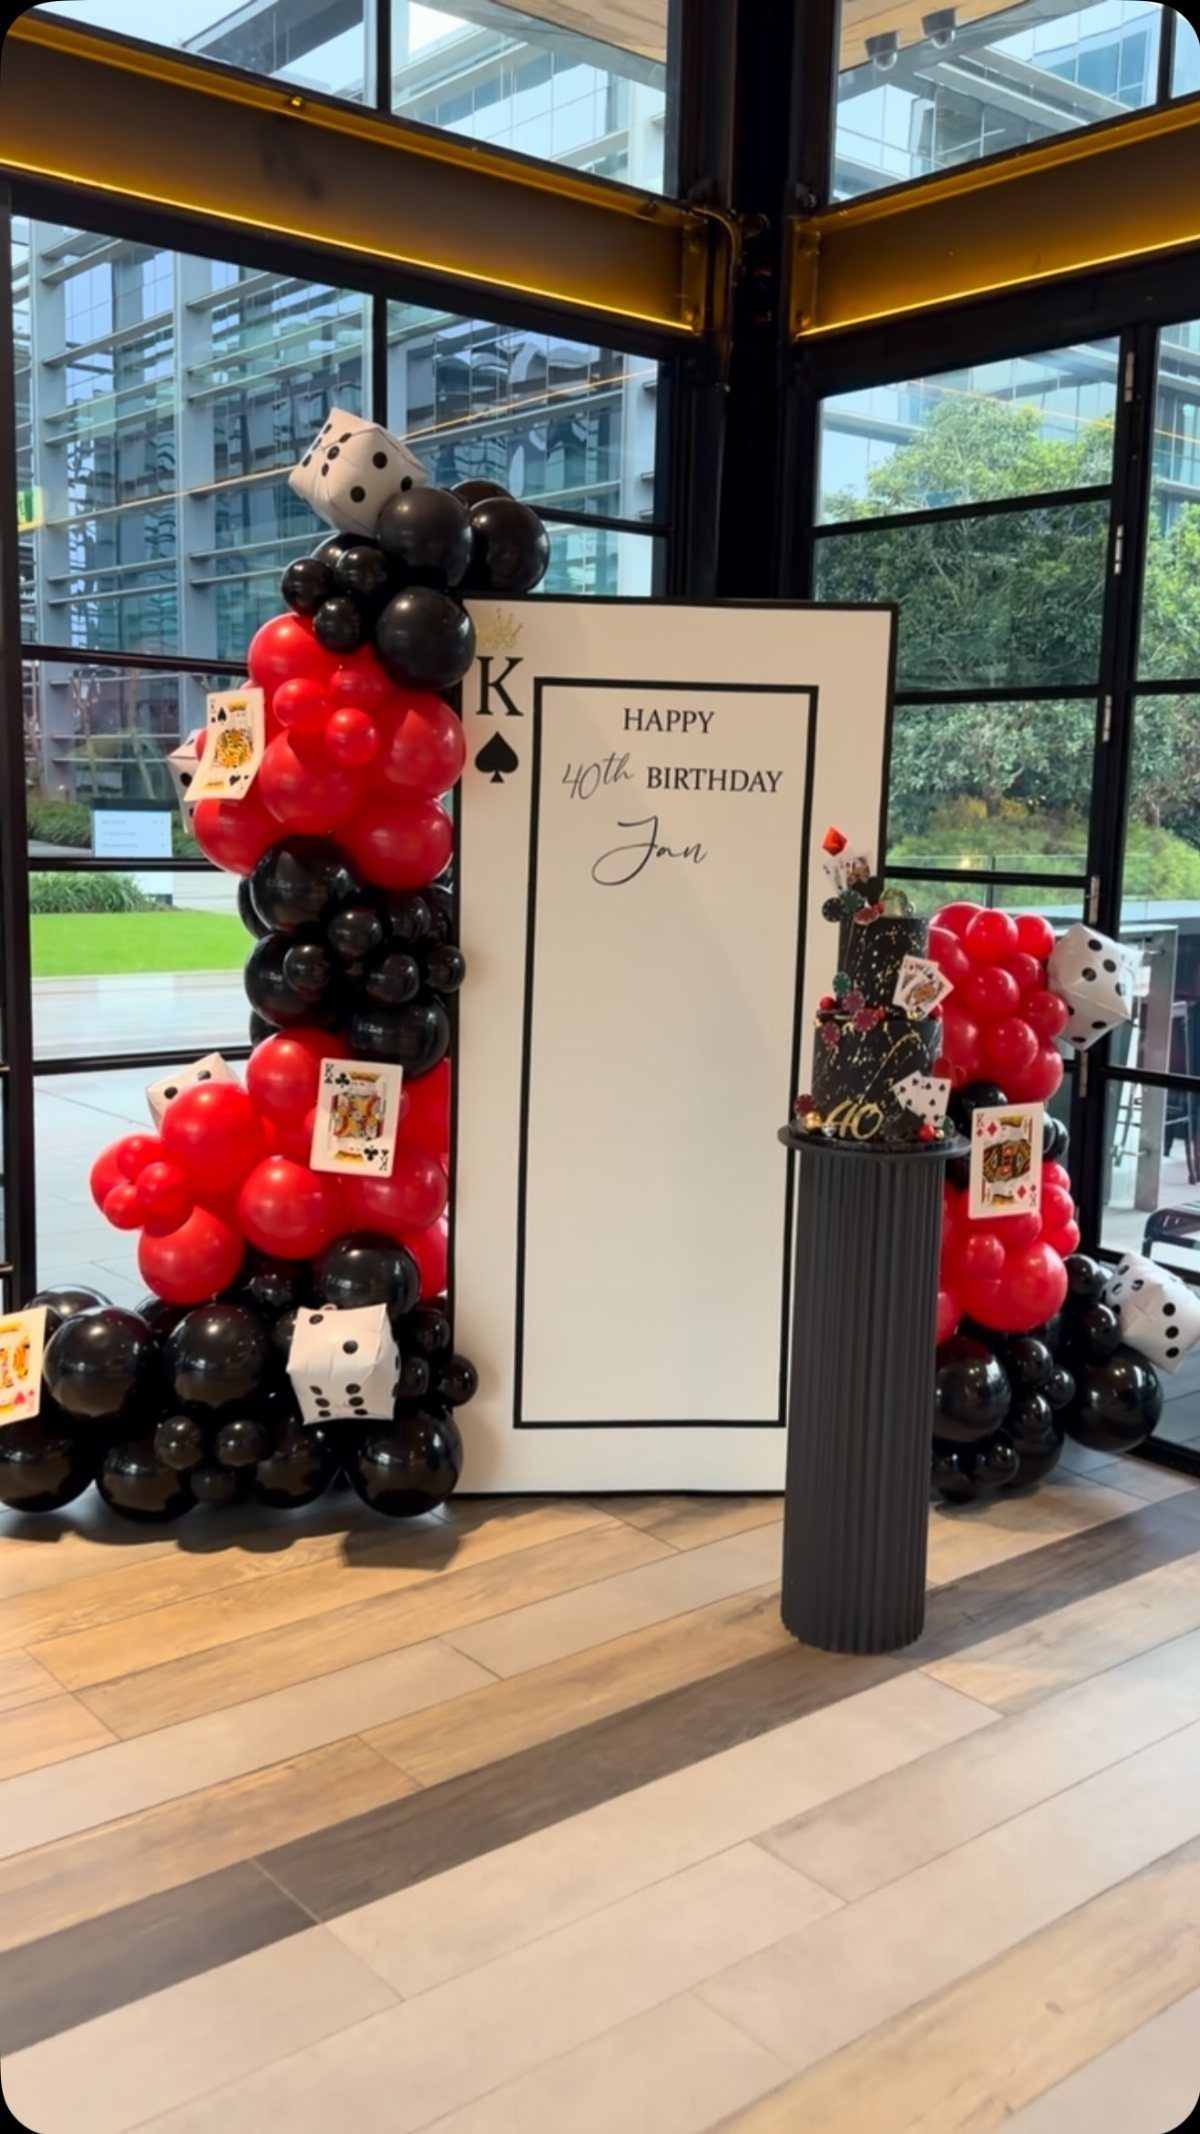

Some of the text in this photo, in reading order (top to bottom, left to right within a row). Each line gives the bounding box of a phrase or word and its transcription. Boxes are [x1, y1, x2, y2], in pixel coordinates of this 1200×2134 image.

[475, 655, 524, 717] K
[622, 707, 715, 734] HAPPY
[561, 752, 784, 800] 40th BIRTHDAY
[591, 815, 708, 887] Jan
[824, 1098, 884, 1140] 40
